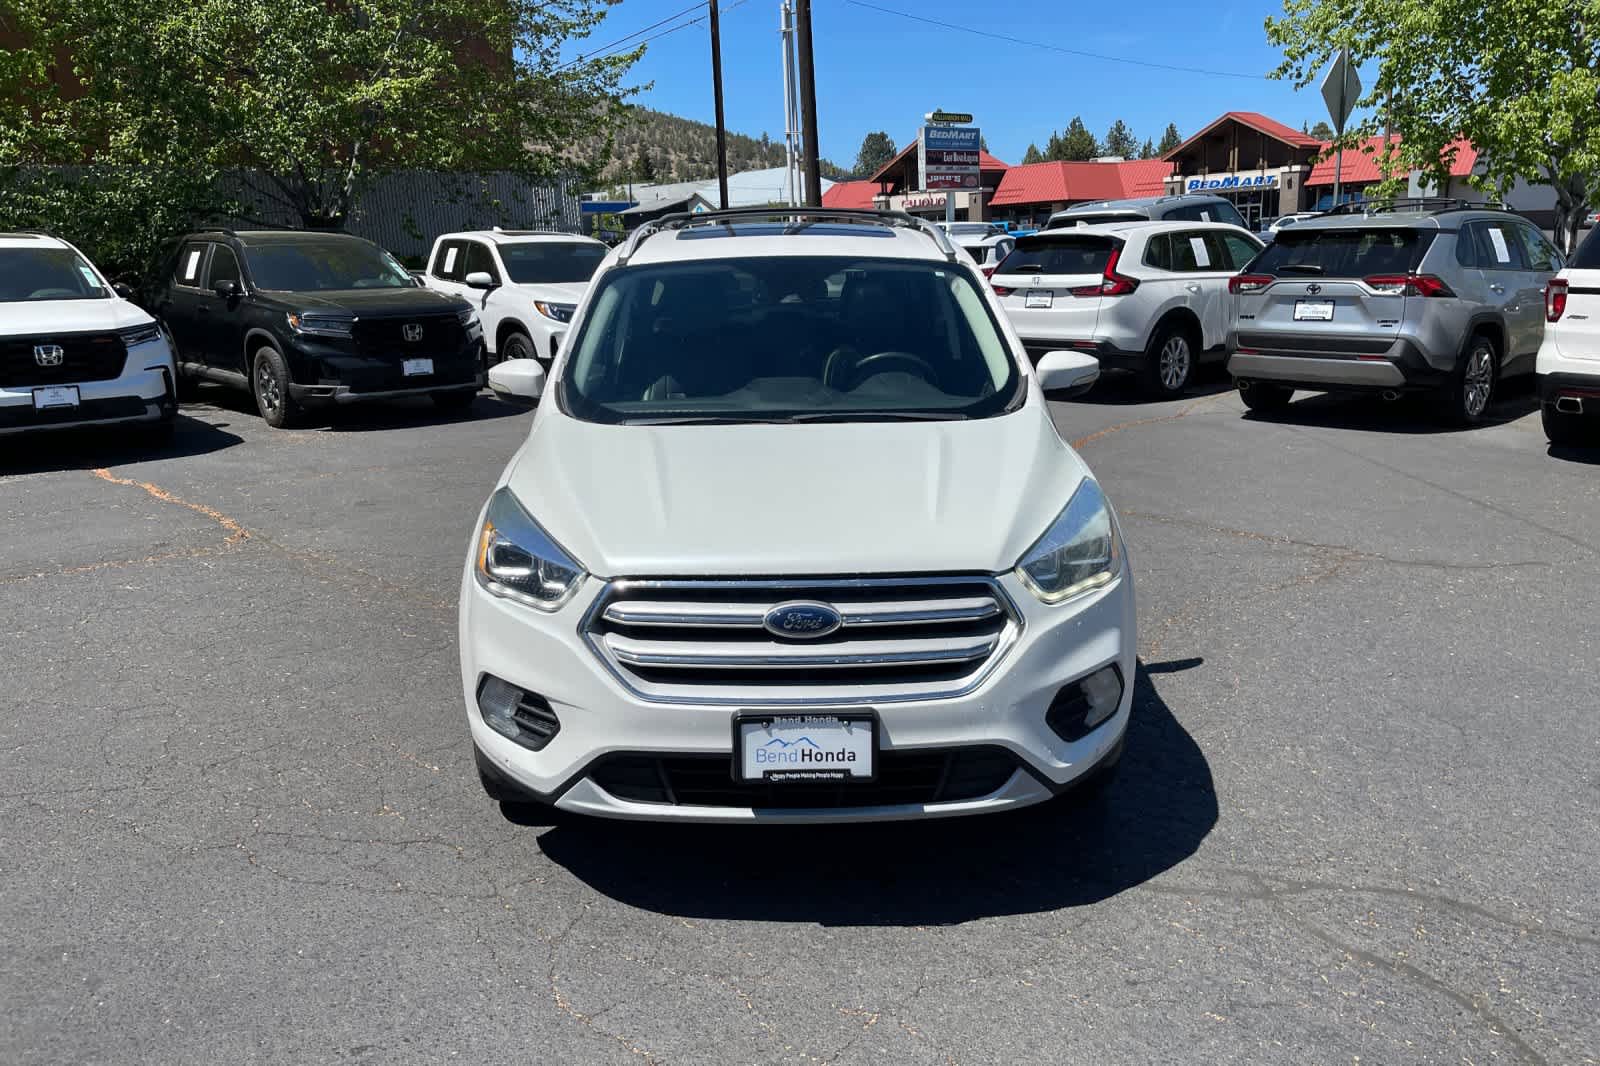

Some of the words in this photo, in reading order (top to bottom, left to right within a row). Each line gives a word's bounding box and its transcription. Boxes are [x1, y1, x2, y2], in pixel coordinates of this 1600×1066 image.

[929, 130, 976, 140] BEDMART
[1188, 175, 1275, 190] BEDMART
[756, 748, 798, 763] Bend
[801, 747, 857, 763] Honda
